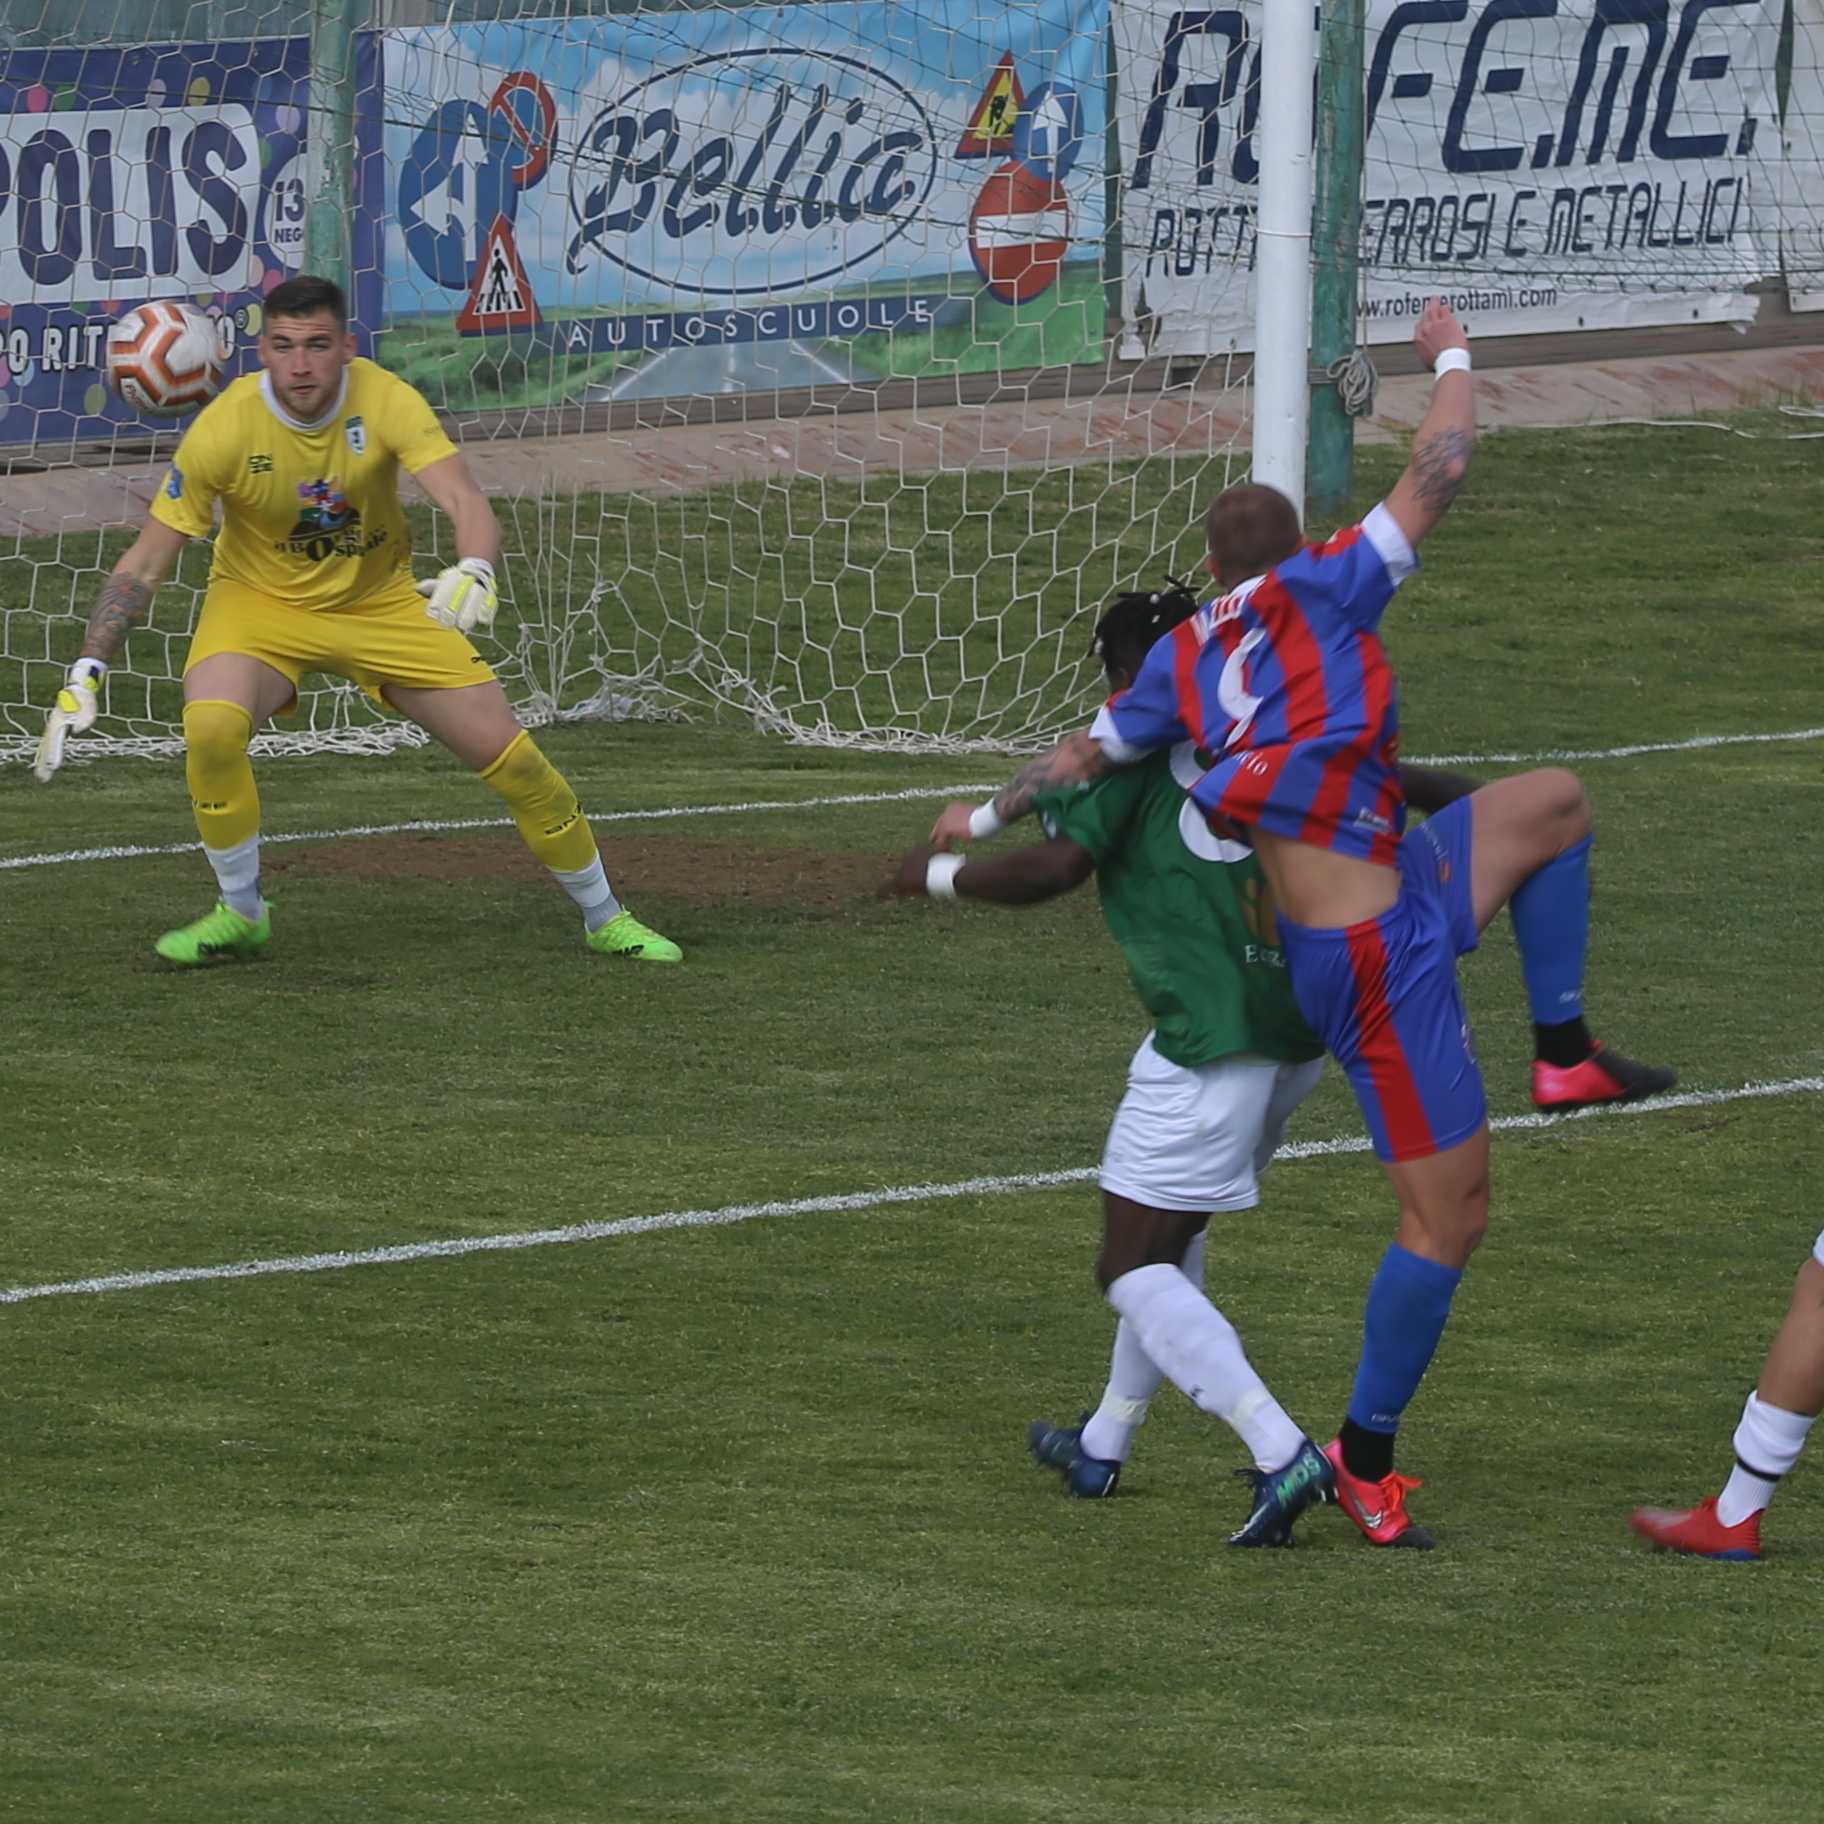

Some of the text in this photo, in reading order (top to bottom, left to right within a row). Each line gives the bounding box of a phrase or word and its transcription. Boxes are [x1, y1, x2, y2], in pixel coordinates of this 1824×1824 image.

[565, 81, 927, 277] Bellia
[1356, 193, 1495, 265] ERROSI
[1503, 190, 1537, 258] E
[1541, 177, 1744, 256] METALLICI
[568, 298, 930, 350] AUTOSCUOLE
